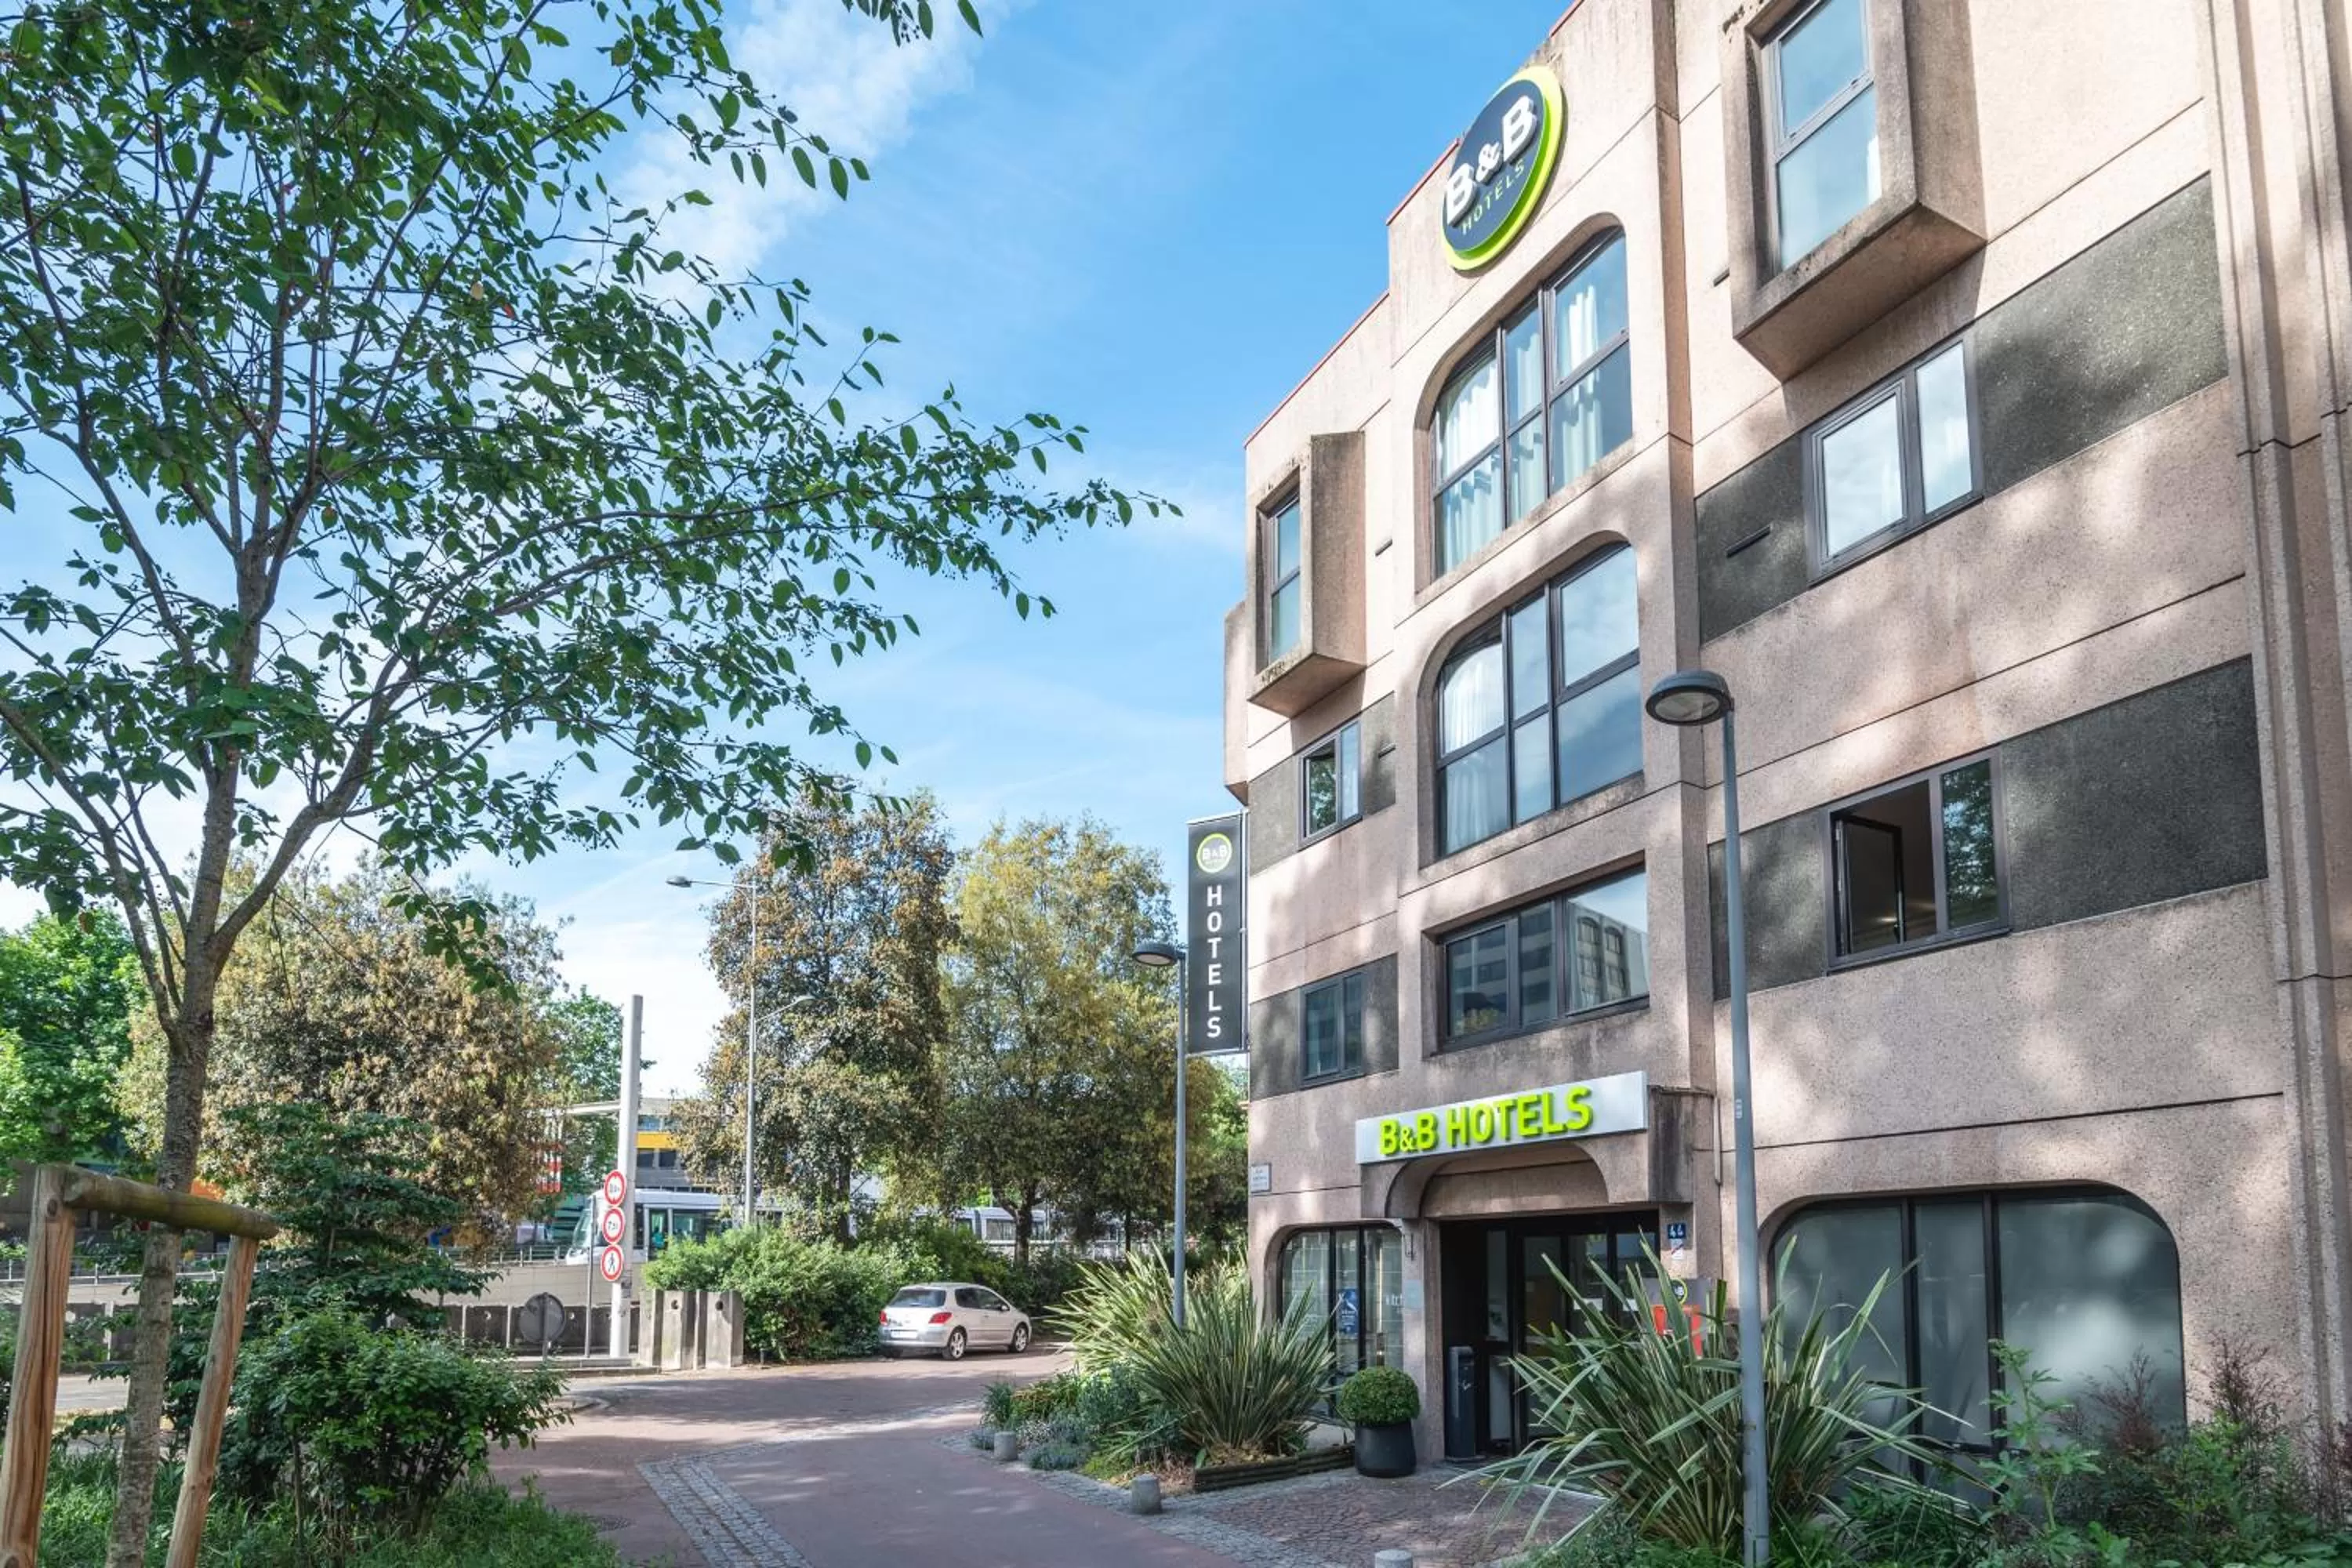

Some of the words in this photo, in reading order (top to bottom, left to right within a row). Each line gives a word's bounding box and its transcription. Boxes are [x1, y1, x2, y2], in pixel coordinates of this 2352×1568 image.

[1445, 95, 1537, 226] B&B
[1461, 158, 1525, 235] HOTELS
[1206, 884, 1223, 1039] HOTELS
[1378, 1112, 1439, 1156] B&B
[1446, 1085, 1594, 1147] HOTELS
